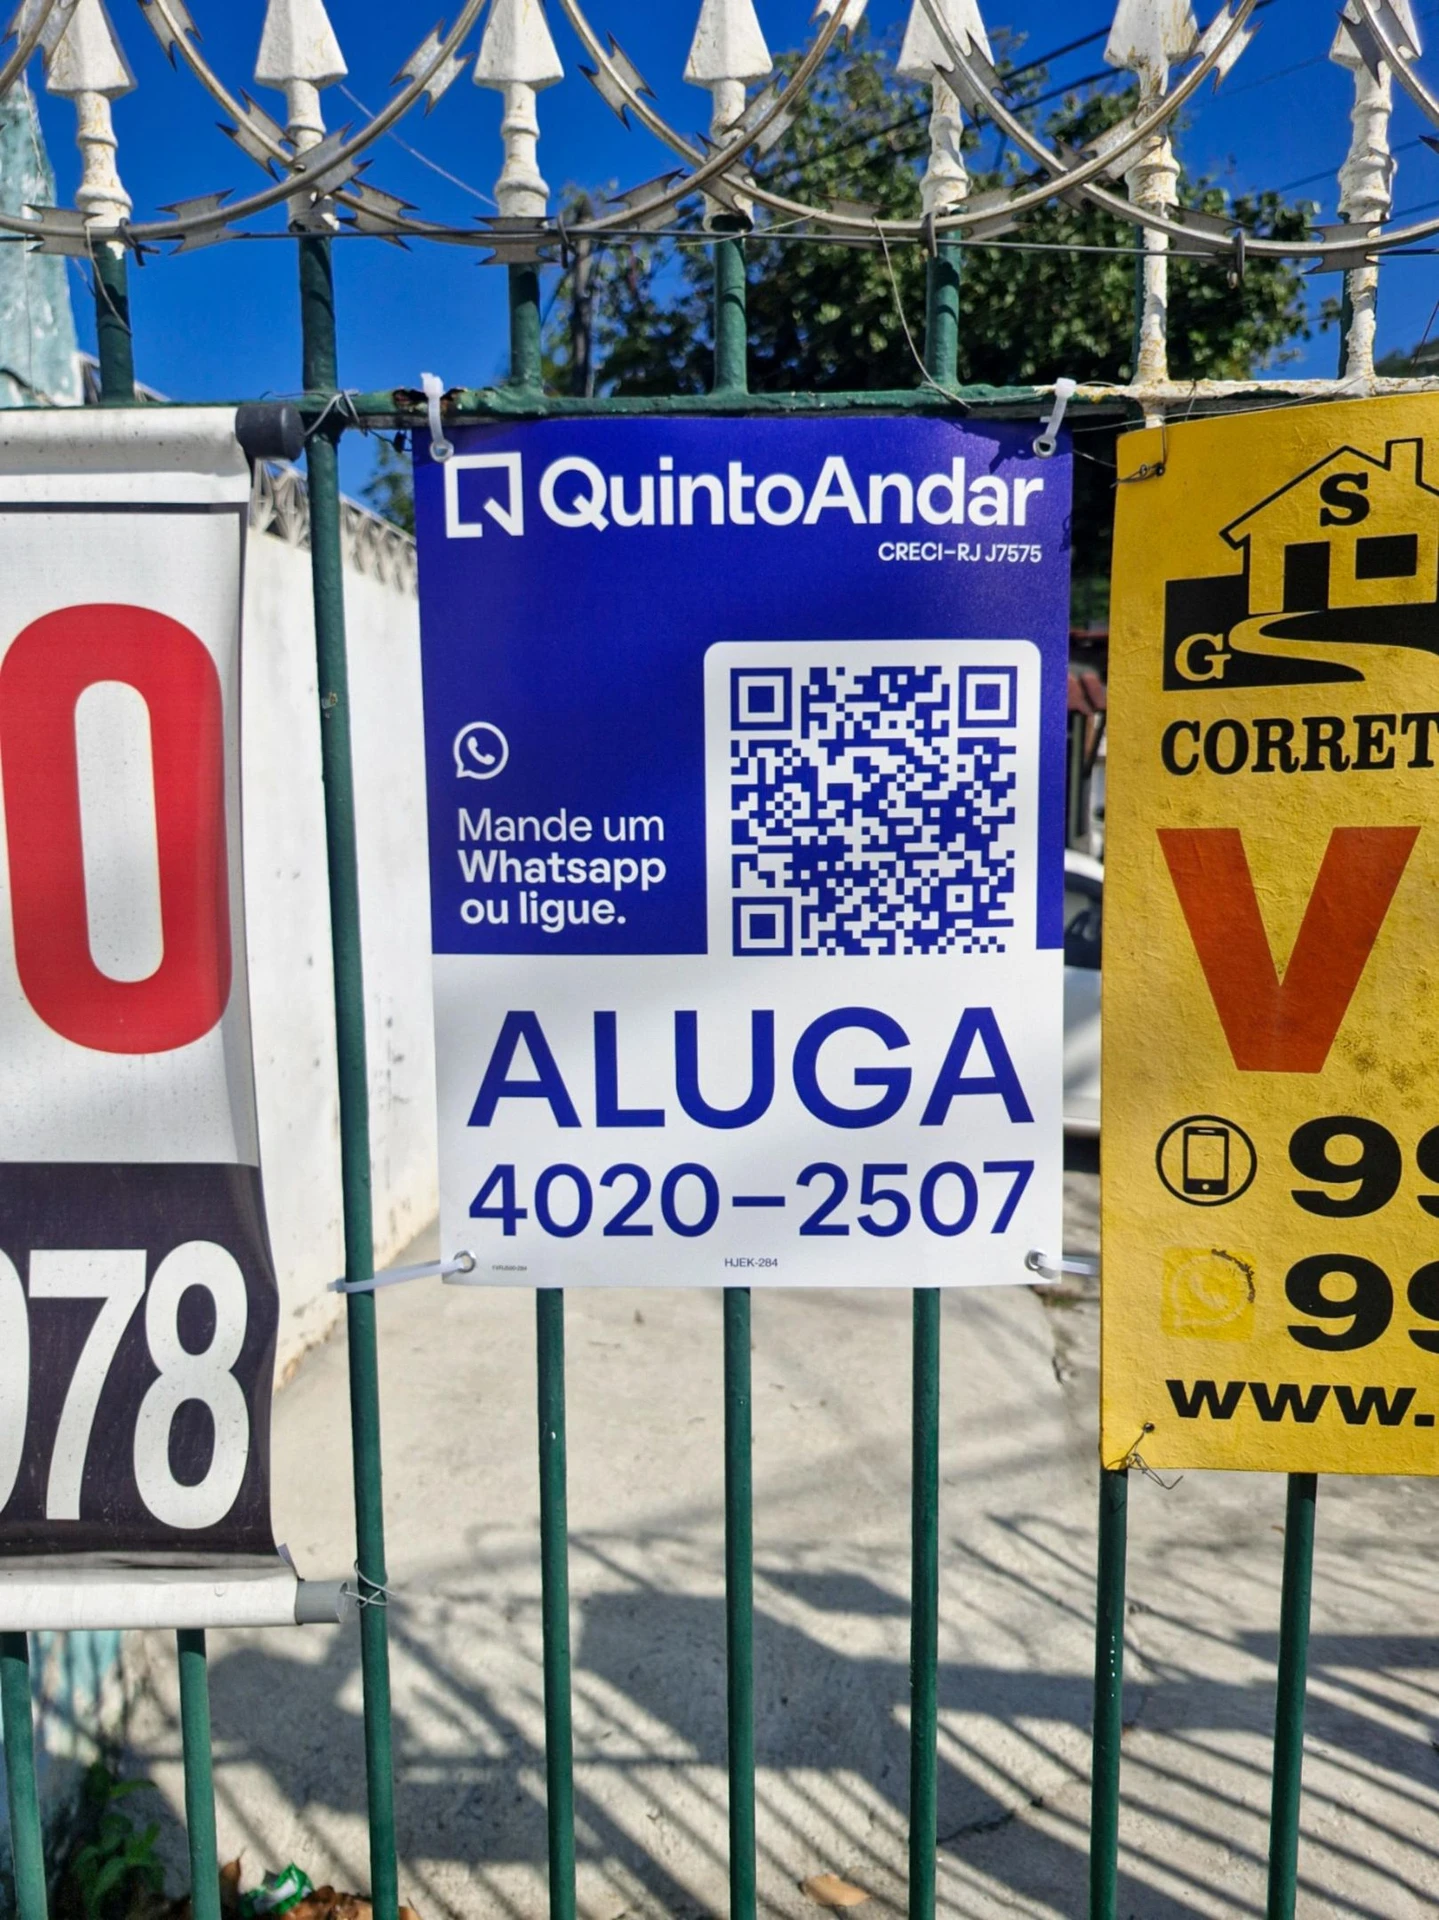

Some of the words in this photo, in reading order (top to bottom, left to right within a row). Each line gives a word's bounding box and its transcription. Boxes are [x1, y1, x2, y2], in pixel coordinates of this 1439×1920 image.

[539, 455, 1044, 532] QuintoAndar
[1319, 472, 1370, 527] S
[878, 542, 980, 562] CRECI-RJ
[985, 543, 1042, 563] J7575
[1174, 633, 1232, 681] G
[1161, 712, 1439, 776] CORRET
[457, 808, 592, 842] Mande
[603, 816, 665, 841] um
[457, 850, 667, 892] Whatsapp
[460, 897, 508, 925] ou
[519, 891, 626, 933] ligue.
[1156, 826, 1421, 1074] V
[466, 1006, 1035, 1130] ALUGA
[1288, 1115, 1439, 1219] 9
[468, 1160, 1035, 1238] 4020-2507
[724, 1257, 778, 1268] HJEK-284
[1284, 1253, 1439, 1354] 9
[0, 1240, 250, 1530] 78
[1165, 1379, 1435, 1427] www.
